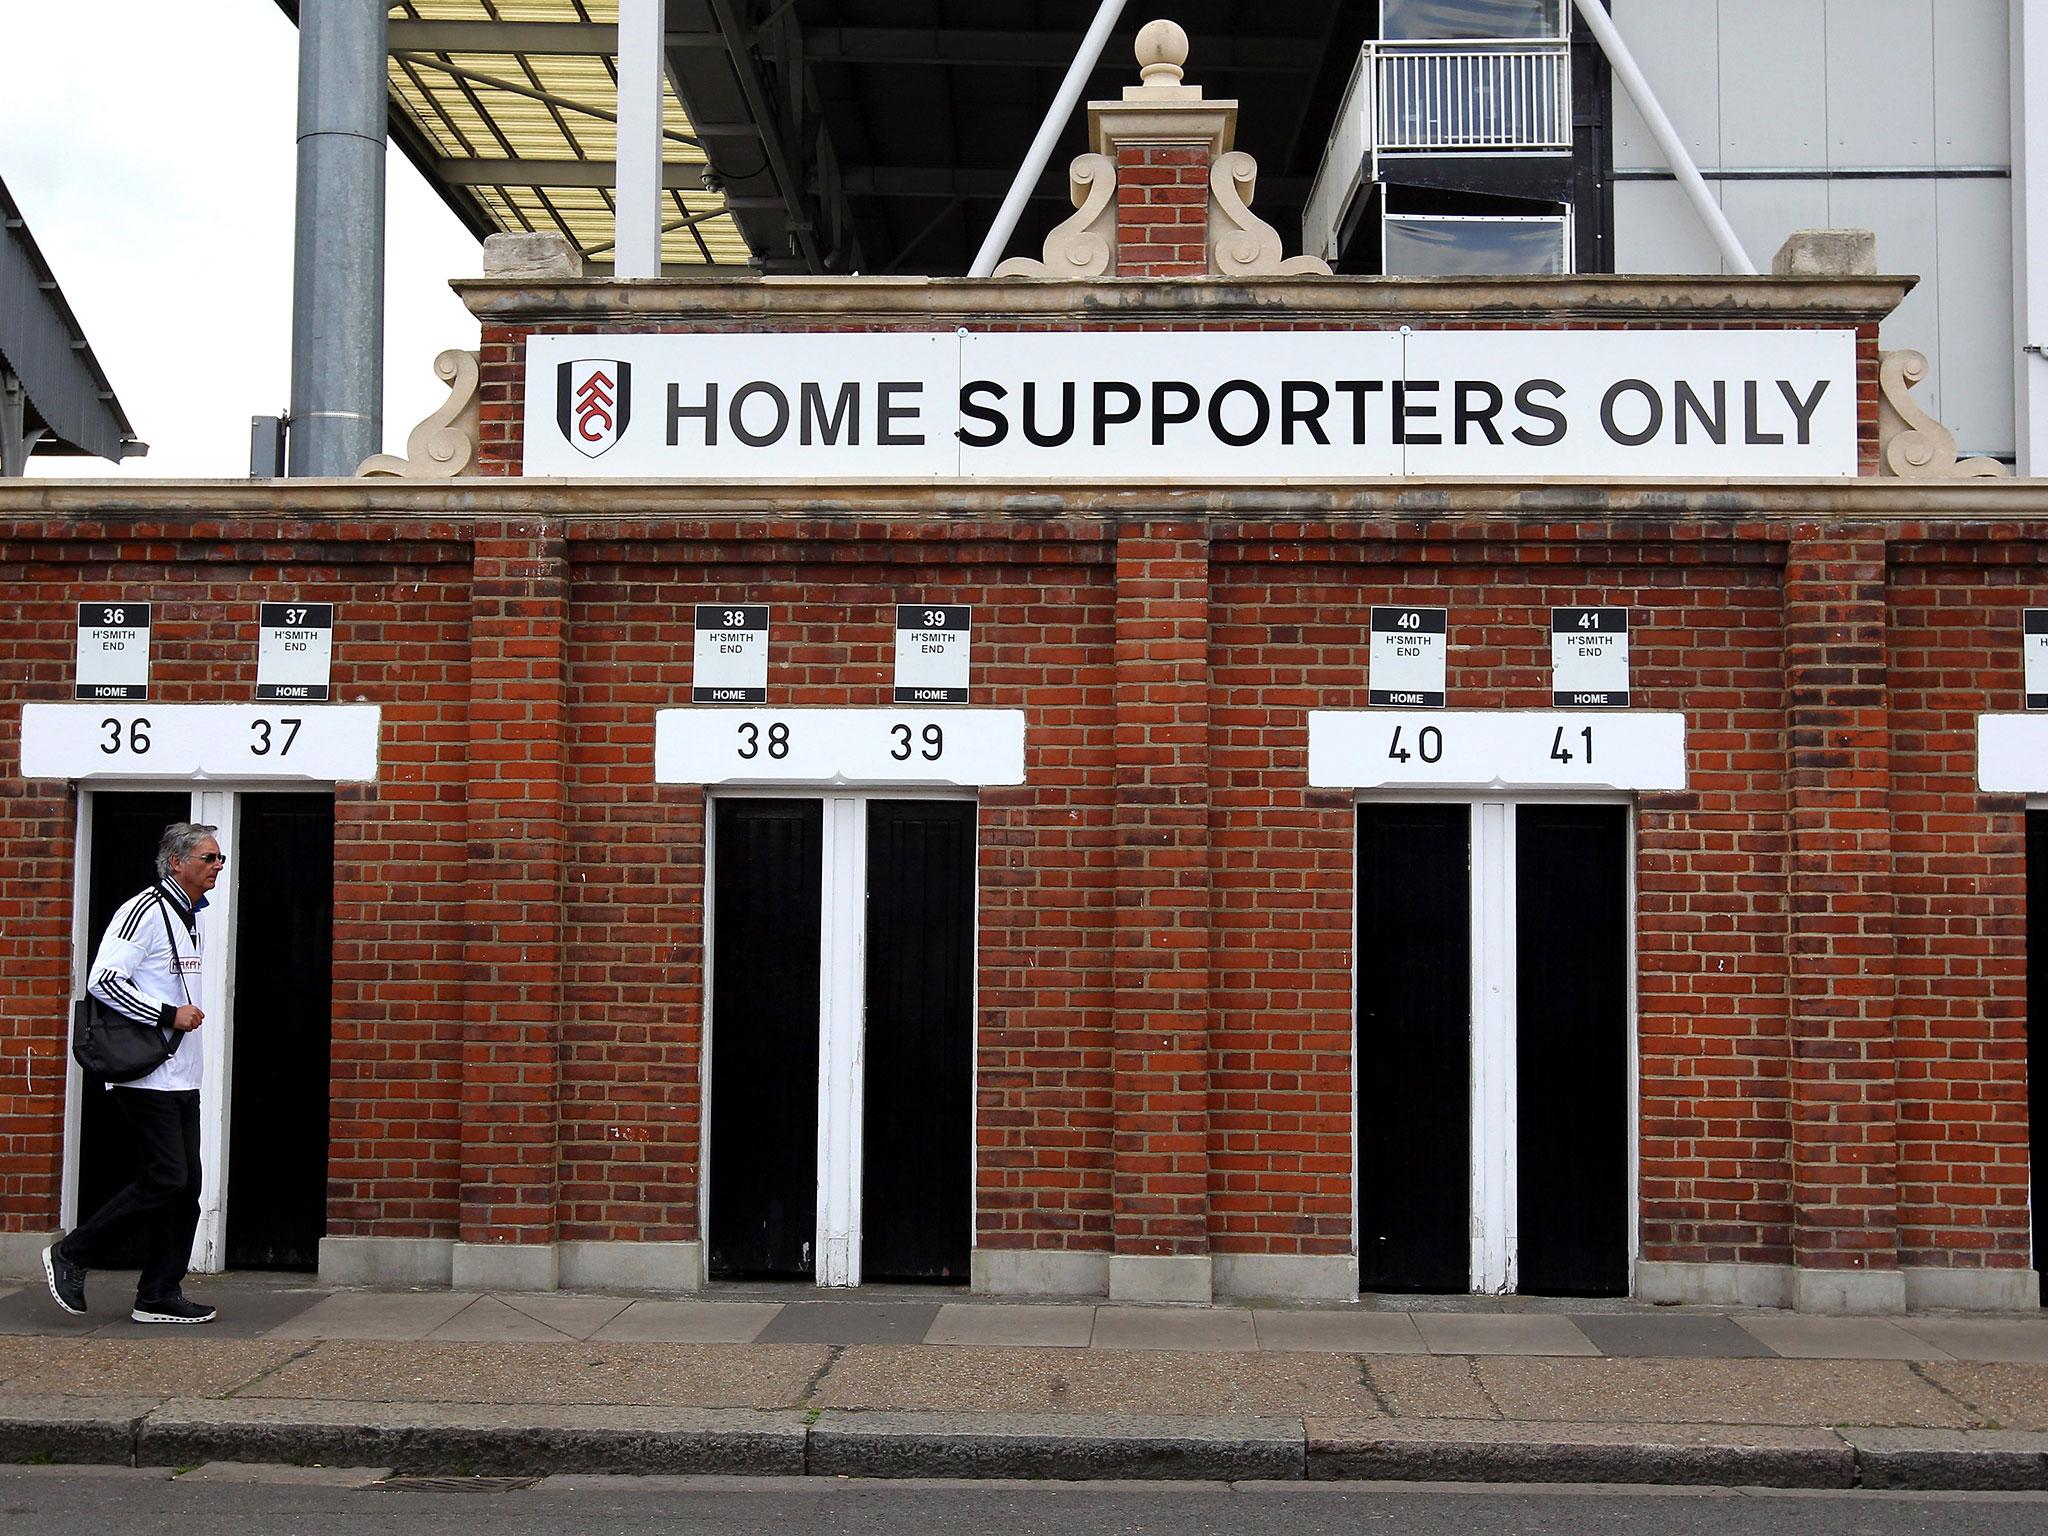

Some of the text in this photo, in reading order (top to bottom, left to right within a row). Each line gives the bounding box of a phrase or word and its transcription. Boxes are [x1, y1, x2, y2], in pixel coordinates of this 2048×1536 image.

[665, 379, 1831, 447] HOME SUPPORTERS ONLY
[103, 608, 125, 624] 36
[285, 608, 308, 625] 37
[722, 610, 745, 627] 38
[922, 610, 946, 627] 39
[1397, 612, 1421, 630] 40
[1578, 612, 1599, 629] 41
[92, 630, 136, 640] H'SMITH
[274, 630, 318, 640] H'SMITH
[709, 632, 754, 643] H'SMITH
[911, 632, 956, 643] H'SMITH
[1386, 635, 1432, 646] H'SMITH
[1567, 635, 1613, 646] H'SMITH
[102, 641, 125, 651] END
[284, 642, 307, 652] END
[719, 644, 743, 654] END
[921, 644, 945, 654] END
[1396, 647, 1420, 657] END
[1578, 647, 1602, 657] END
[95, 686, 128, 697] HOME
[275, 686, 309, 697] HOME
[712, 689, 746, 700] HOME
[914, 689, 948, 700] HOME
[1389, 692, 1424, 704] HOME
[1573, 693, 1609, 704] HOME
[101, 718, 301, 755] 36 37
[738, 722, 942, 761] 38 39
[1389, 726, 1591, 764] 40 41
